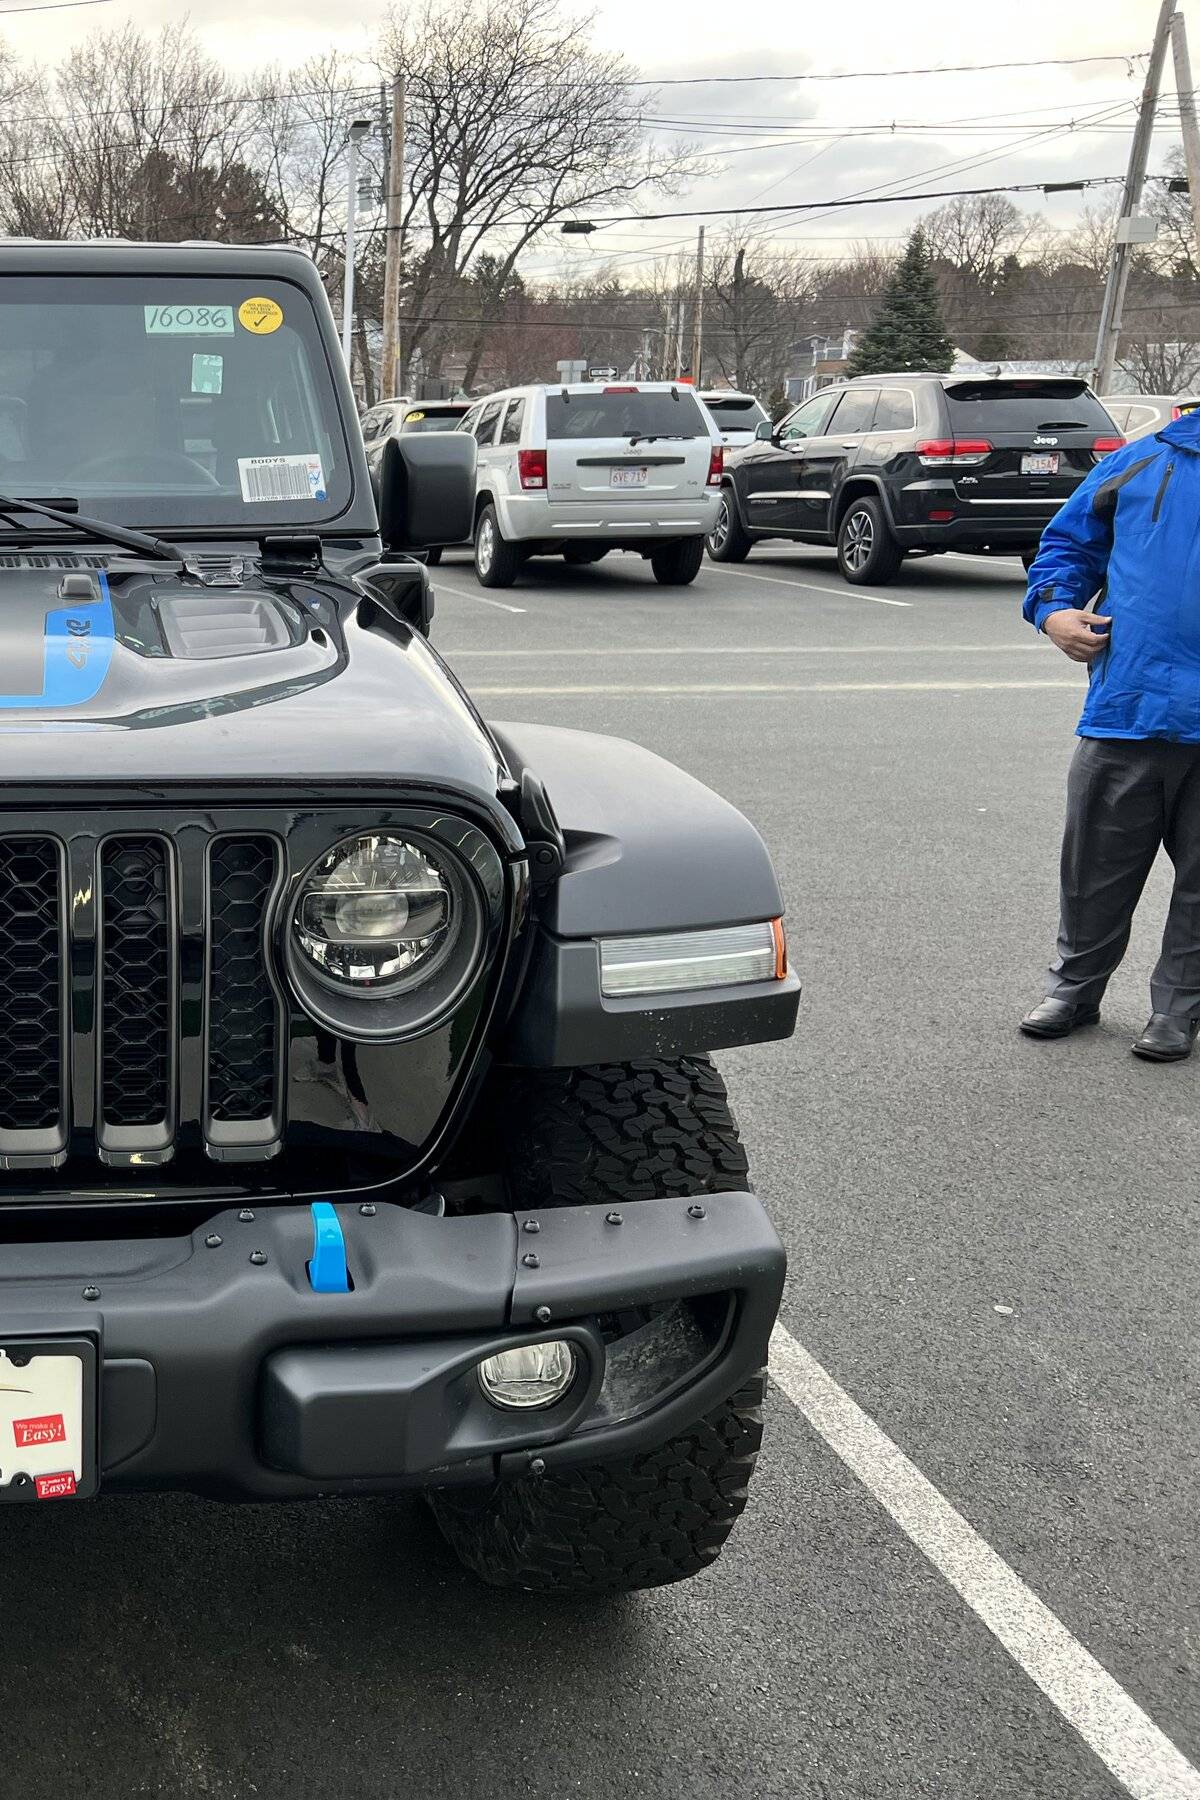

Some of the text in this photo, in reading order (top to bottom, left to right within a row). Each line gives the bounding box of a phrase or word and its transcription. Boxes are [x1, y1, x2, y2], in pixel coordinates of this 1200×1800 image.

[150, 305, 226, 328] 16086
[1033, 436, 1058, 446] Jeep
[22, 1424, 62, 1443] Easy!
[41, 1476, 73, 1496] Easy!
